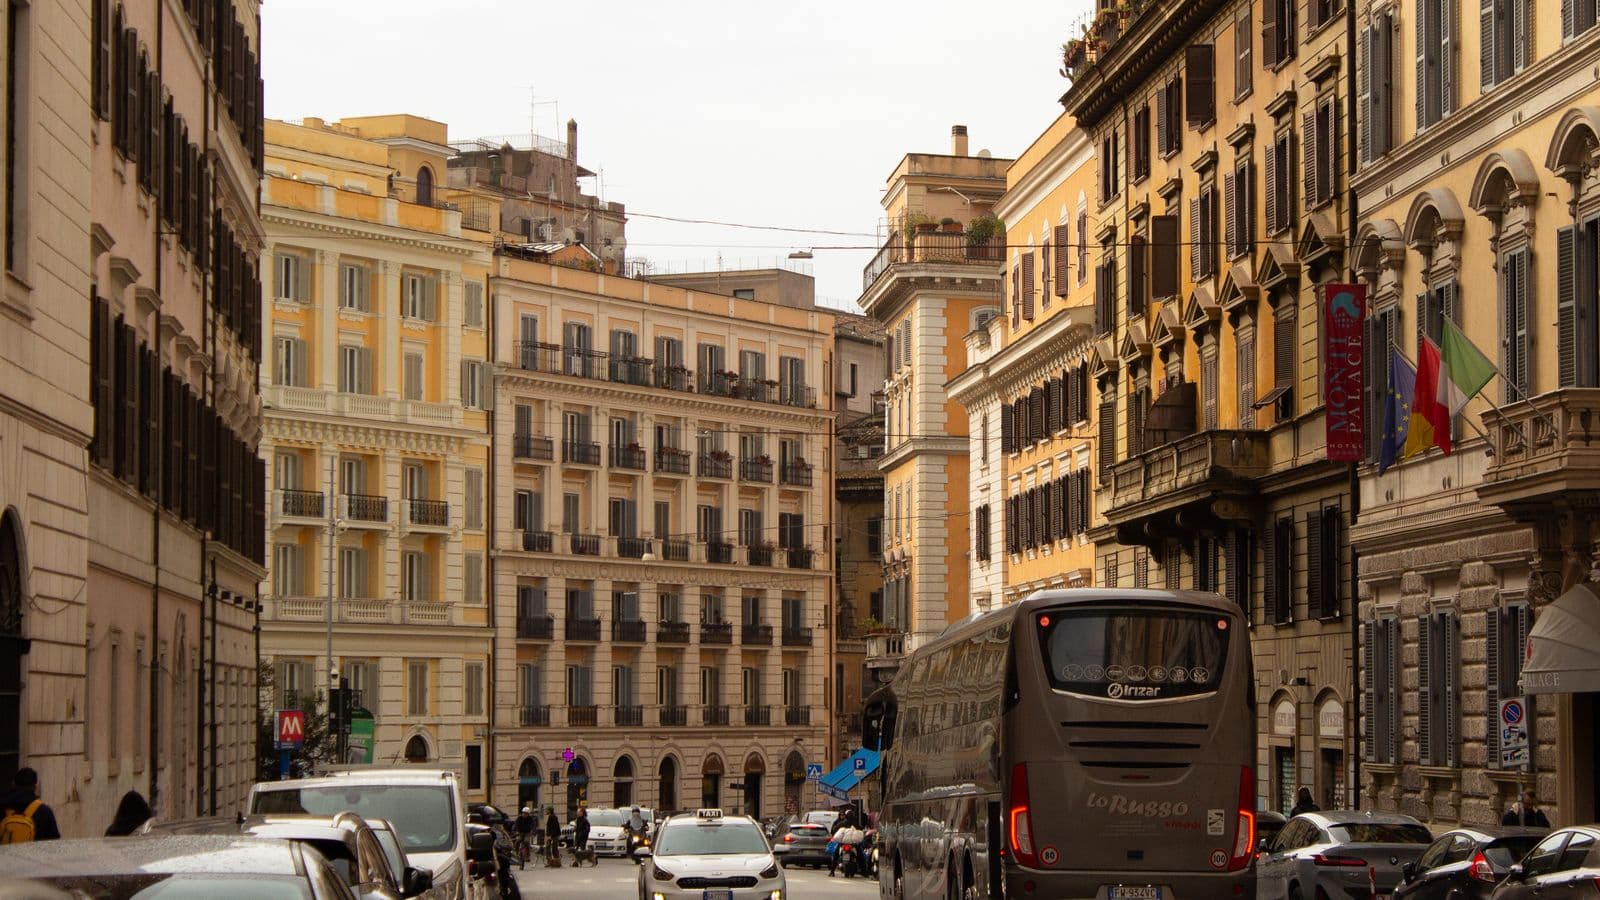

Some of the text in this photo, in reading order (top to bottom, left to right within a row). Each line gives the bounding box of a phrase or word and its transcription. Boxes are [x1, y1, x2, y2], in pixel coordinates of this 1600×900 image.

[1329, 336, 1348, 432] MONTI
[1348, 335, 1362, 433] PALACE
[281, 716, 302, 735] M
[855, 759, 863, 769] P
[1108, 793, 1189, 818] Russo
[1044, 852, 1056, 860] 80
[1212, 854, 1226, 864] 100
